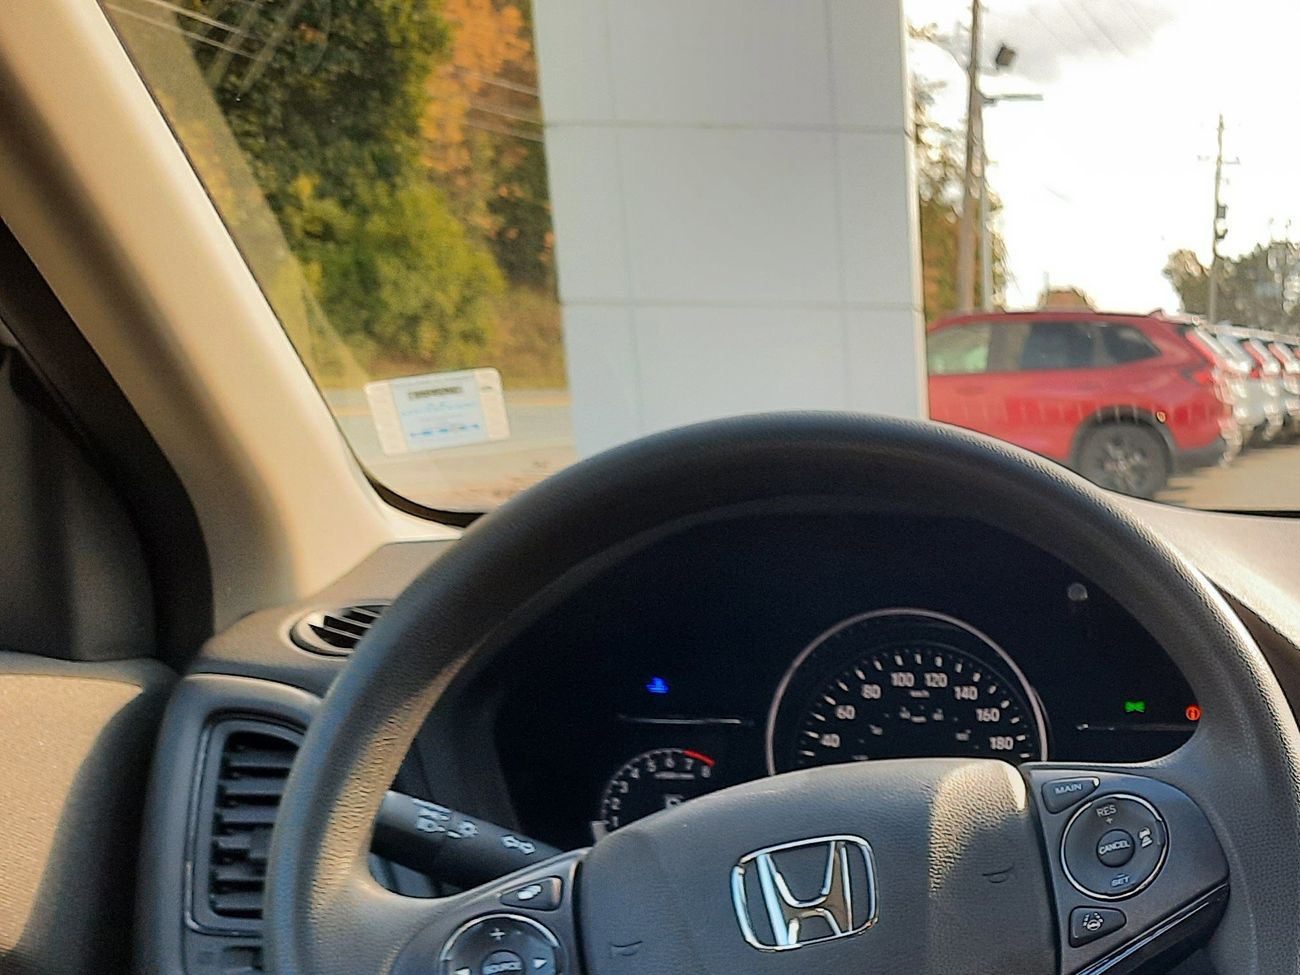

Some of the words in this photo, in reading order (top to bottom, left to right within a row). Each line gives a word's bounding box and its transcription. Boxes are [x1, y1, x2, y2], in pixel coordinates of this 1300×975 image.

[891, 672, 914, 687] 100
[924, 673, 948, 687] 120
[861, 684, 881, 699] 80
[954, 685, 978, 700] 140
[976, 708, 1000, 722] 160
[820, 734, 840, 748] 40
[989, 736, 1014, 750] 180
[1055, 783, 1082, 795] MAIN
[1097, 804, 1117, 817] RES
[1099, 840, 1130, 855] CANCEL
[1111, 875, 1130, 886] SET
